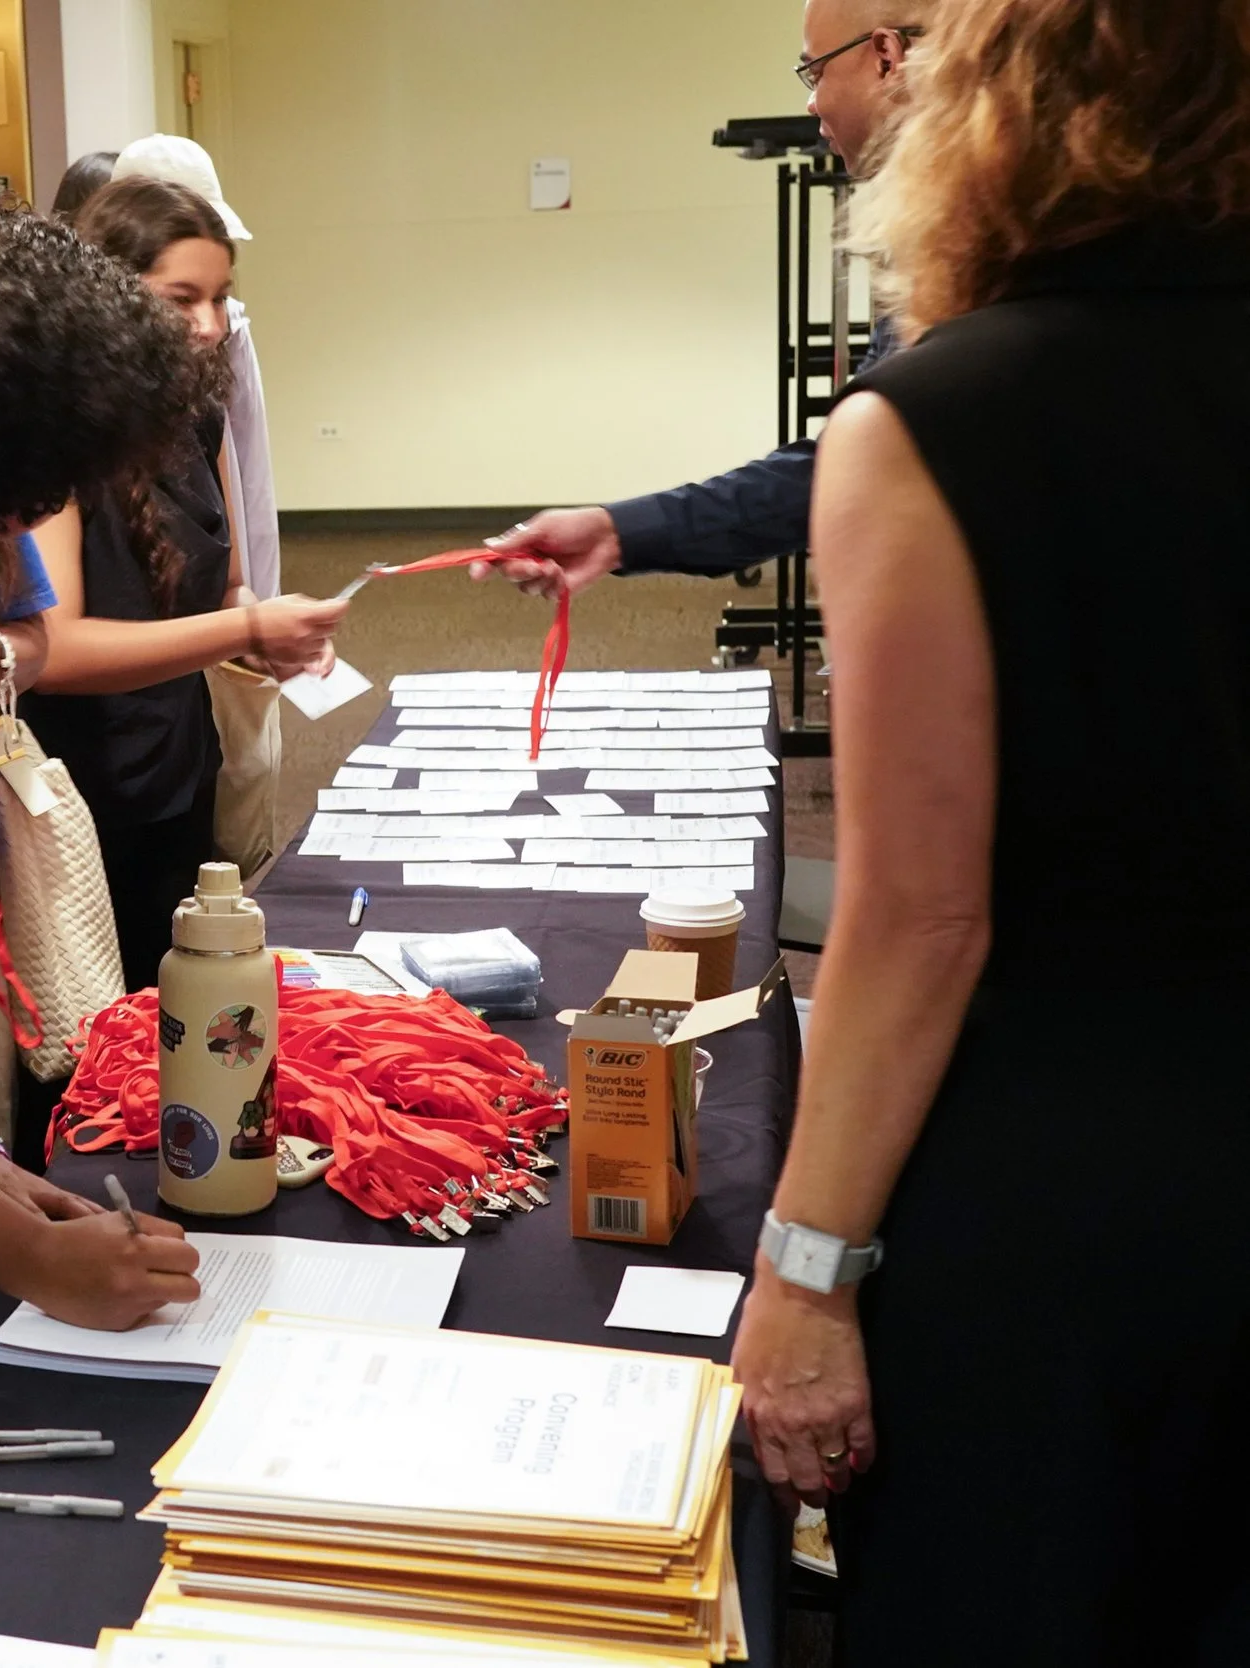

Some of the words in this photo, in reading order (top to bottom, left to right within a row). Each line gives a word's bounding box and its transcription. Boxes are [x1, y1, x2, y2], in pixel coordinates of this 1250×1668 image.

[585, 1073, 622, 1086] Round
[585, 1084, 615, 1098] Stylo
[616, 1087, 647, 1099] Rond
[491, 1397, 536, 1464] Program
[522, 1392, 578, 1475] Convening
